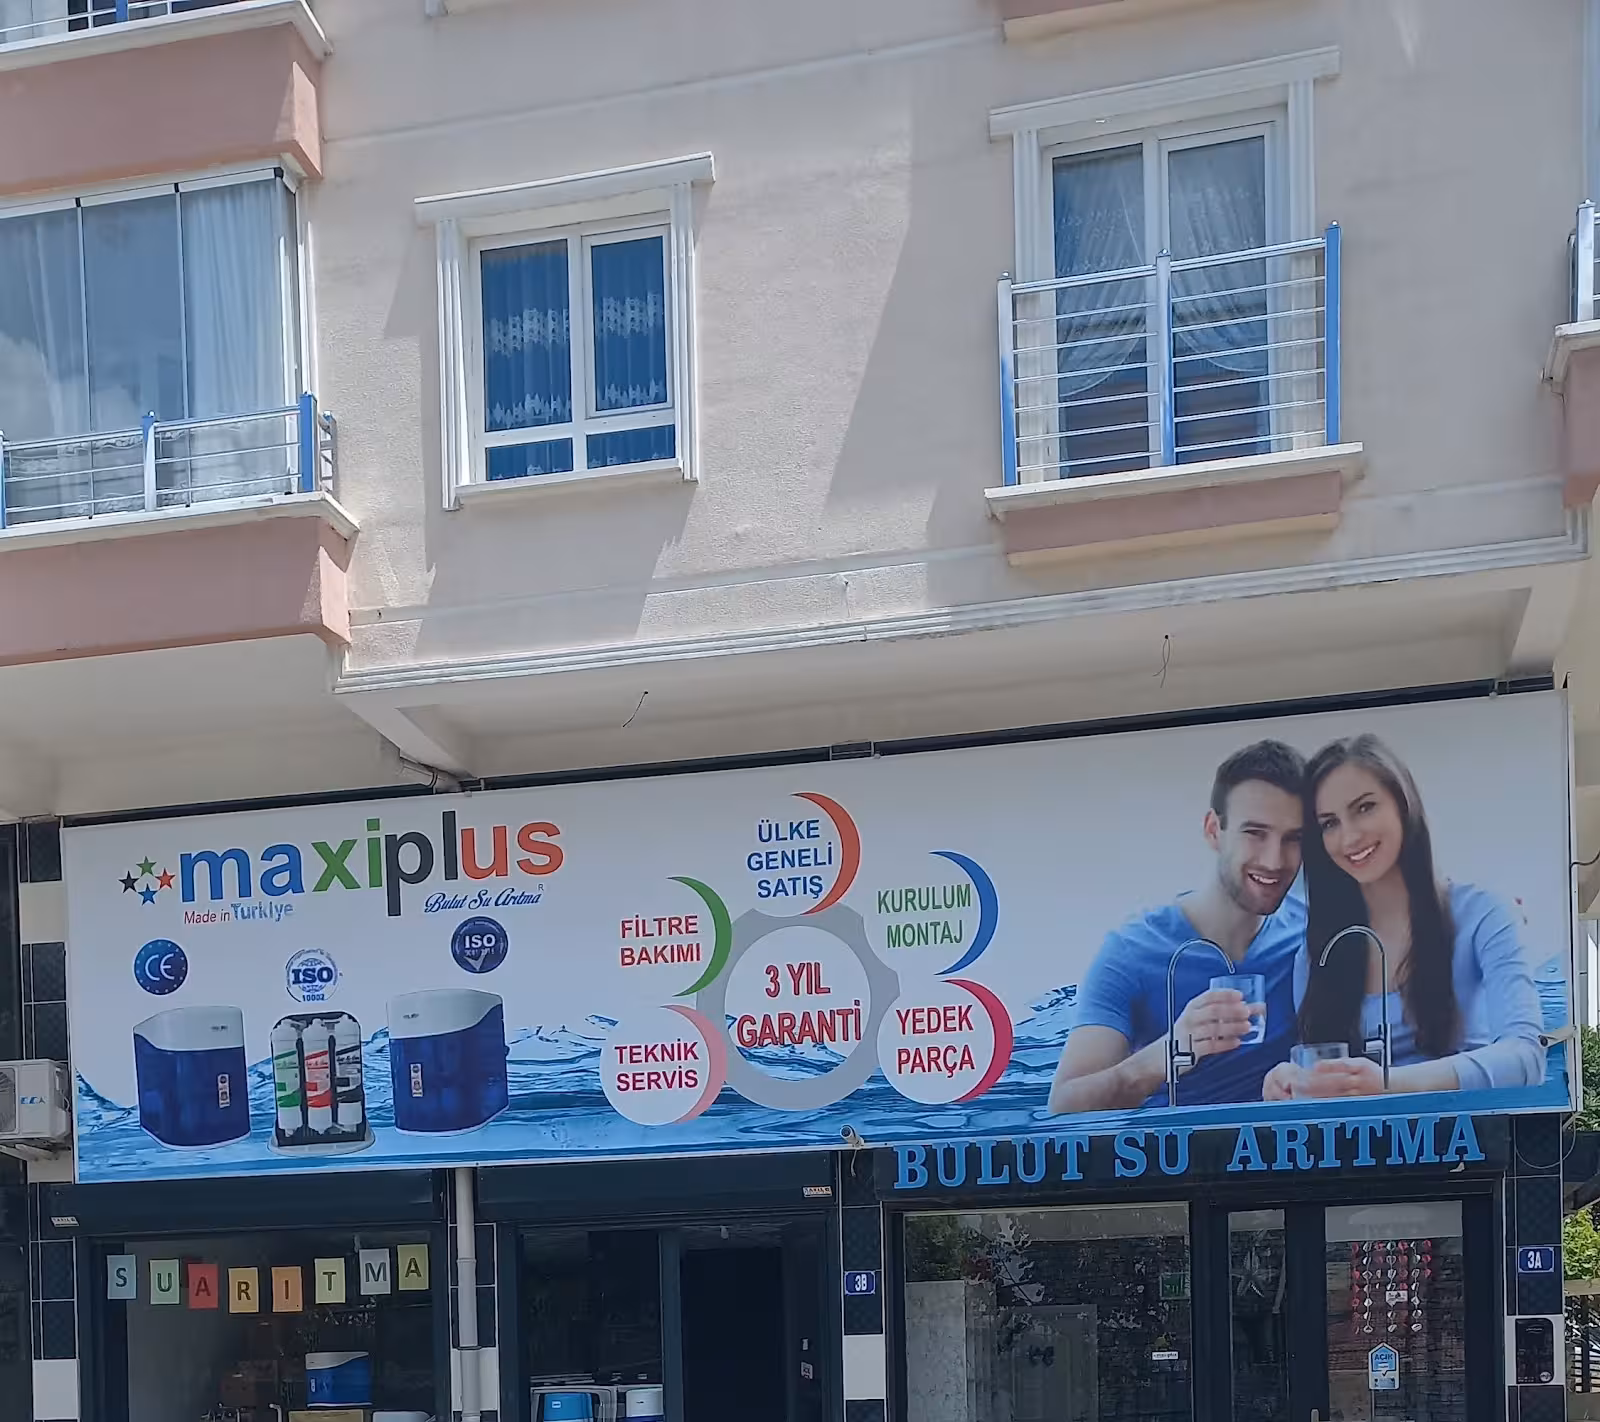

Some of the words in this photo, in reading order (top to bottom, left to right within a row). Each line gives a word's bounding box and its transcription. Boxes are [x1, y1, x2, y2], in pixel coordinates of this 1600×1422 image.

[757, 818, 821, 843] ÜLKE
[179, 810, 565, 917] maxiplus
[746, 841, 834, 871] GENELİ
[756, 875, 825, 899] SATIŞ
[877, 883, 972, 914] KURULUM
[424, 892, 468, 913] Bulut
[468, 889, 492, 910] Su
[184, 910, 217, 925] Made
[220, 908, 231, 922] in
[620, 913, 699, 939] FİLTRE
[464, 933, 496, 949] ISO
[886, 920, 964, 949] MONTAJ
[145, 953, 175, 981] CE
[619, 942, 702, 967] BAKIMI
[291, 966, 334, 985] ISO
[764, 964, 780, 998] 3
[786, 962, 831, 996] YIL
[736, 1000, 862, 1049] GARANTİ
[895, 1004, 975, 1036] YEDEK
[614, 1037, 700, 1065] TEKNİK
[896, 1043, 976, 1079] PARÇA
[615, 1065, 699, 1092] SERVİS
[893, 1135, 1090, 1189] BULUT
[1114, 1128, 1193, 1178] SU
[1226, 1114, 1486, 1172] ARITMA
[1527, 1250, 1542, 1269] 3A
[855, 1273, 867, 1291] 3B
